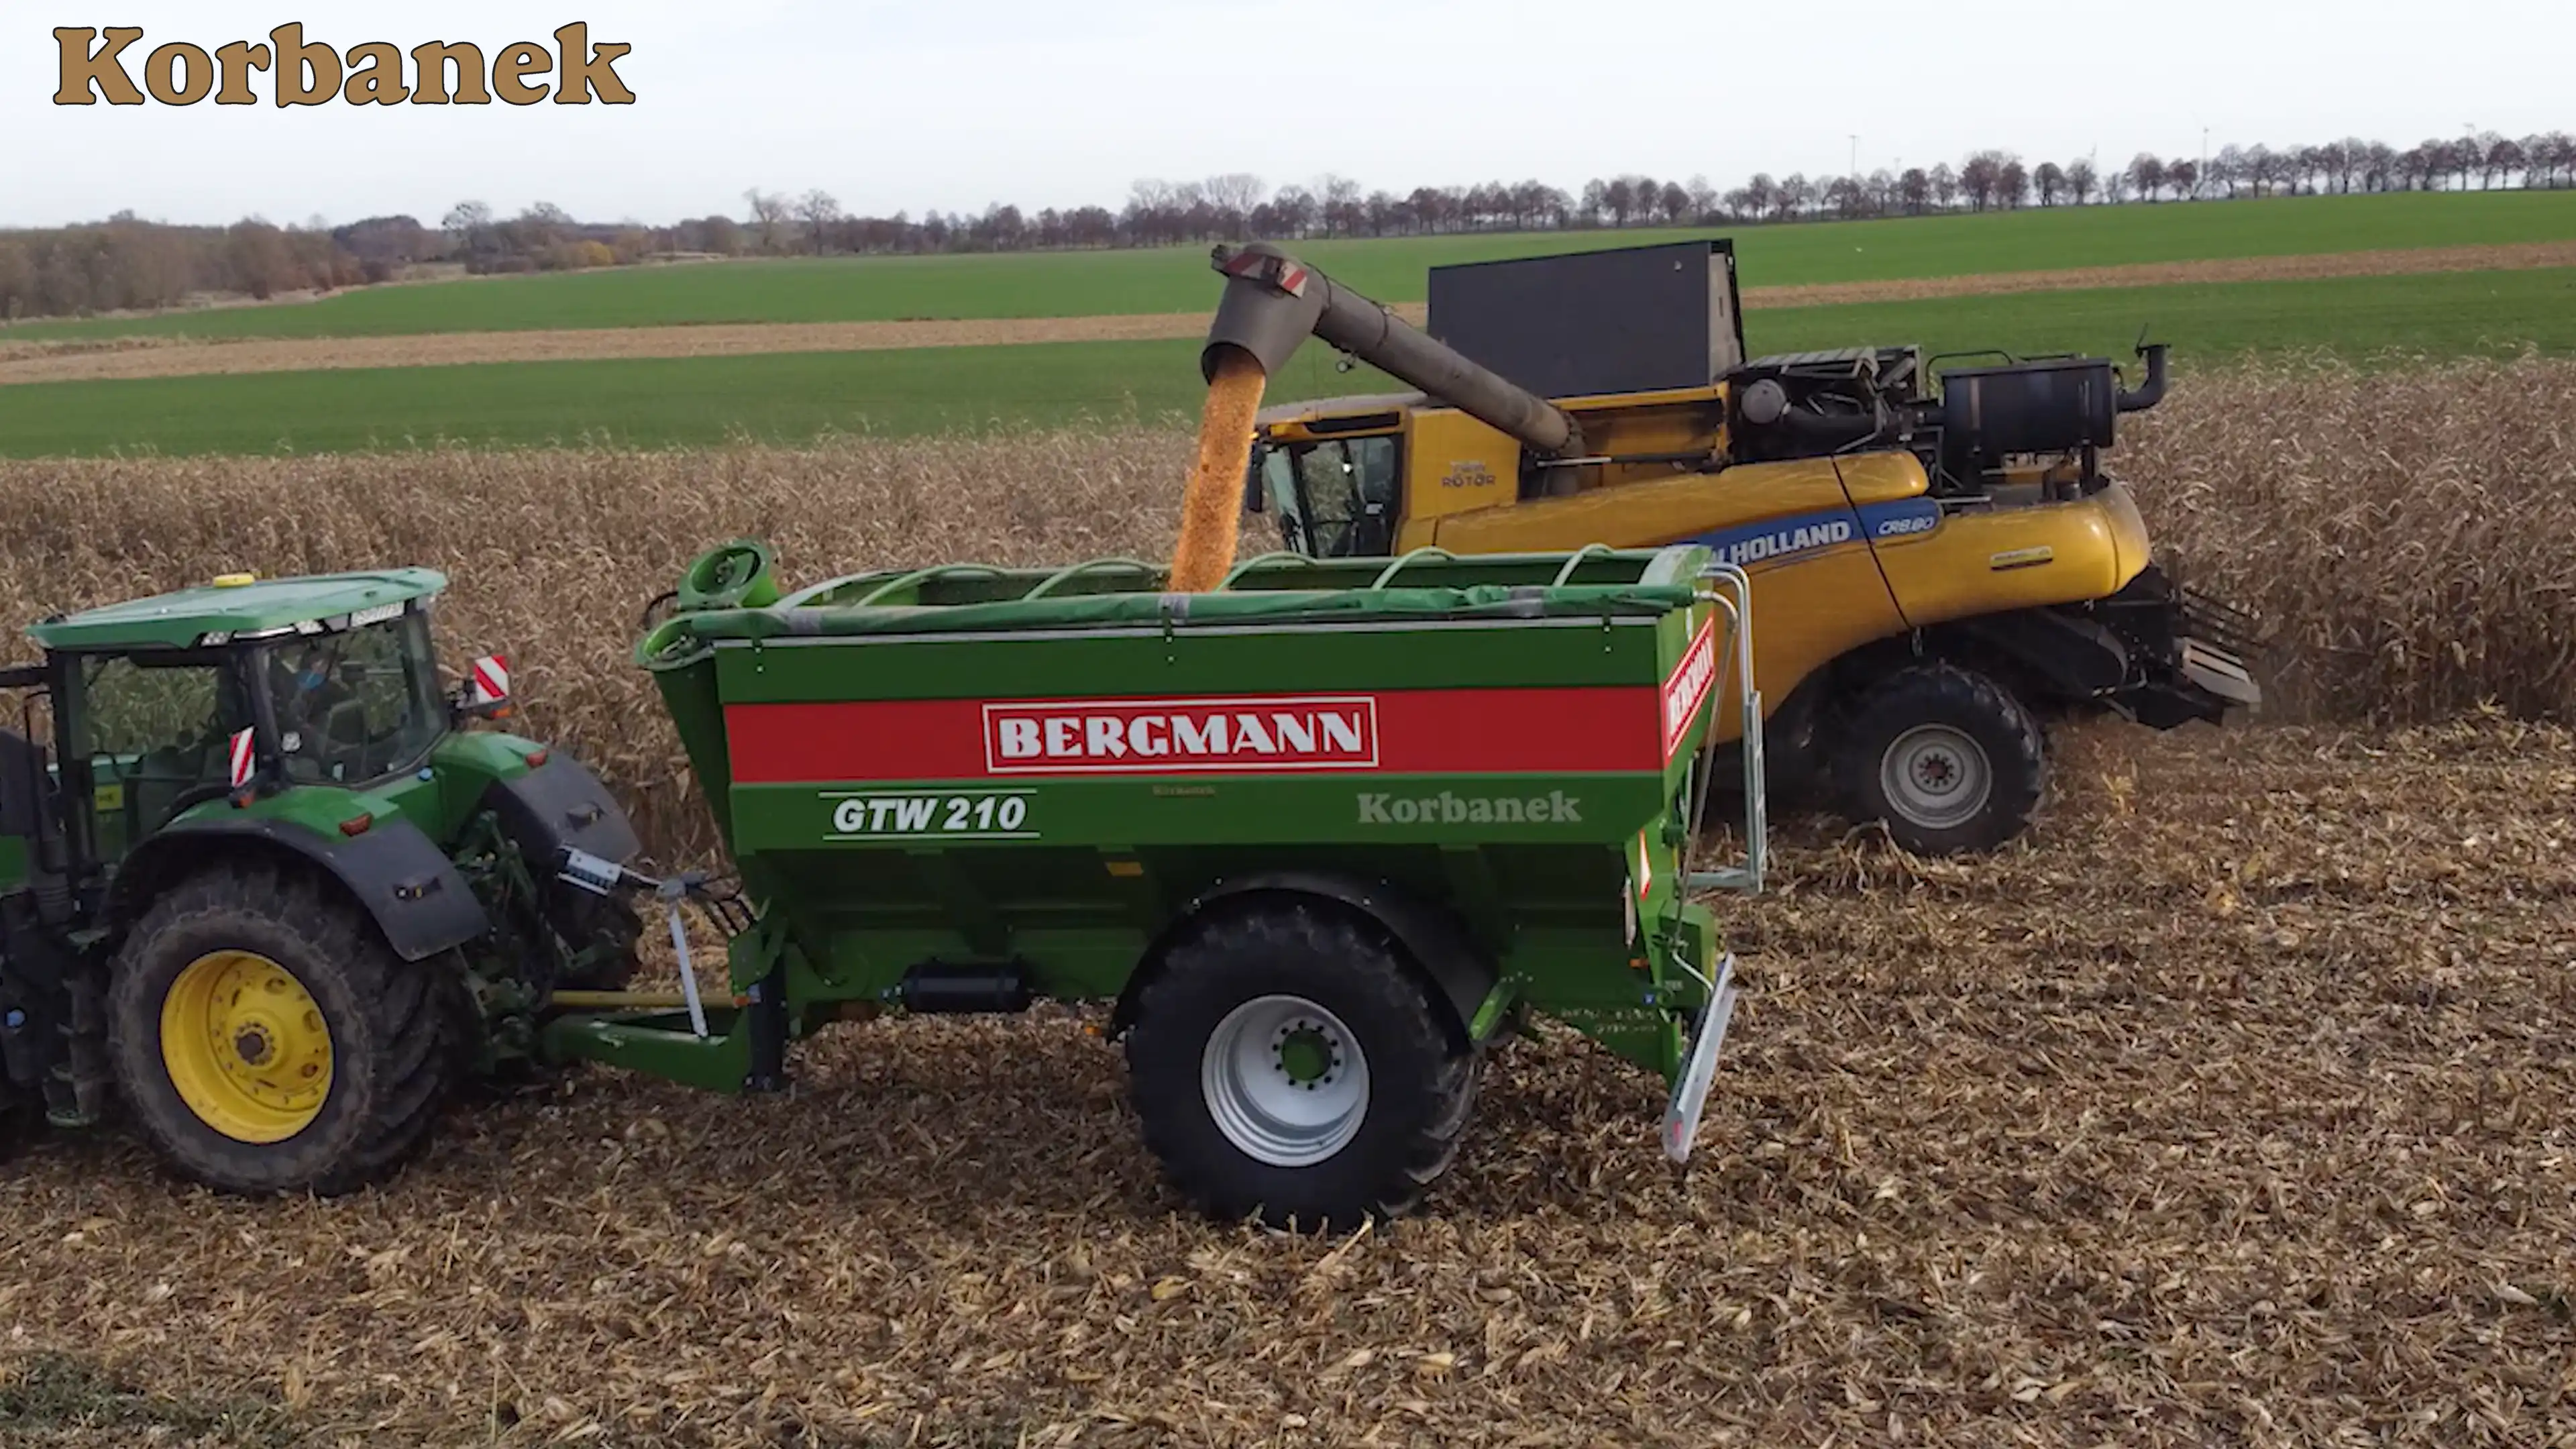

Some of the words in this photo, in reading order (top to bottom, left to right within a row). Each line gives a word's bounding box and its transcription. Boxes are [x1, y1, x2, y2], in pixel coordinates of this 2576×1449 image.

[1442, 473, 1496, 488] ROTOR
[1729, 521, 1851, 565] HOLLAND
[999, 712, 1361, 758] BERGMANN
[833, 798, 938, 832] GTW
[942, 796, 1026, 830] 210
[1357, 790, 1582, 823] Korbanek
